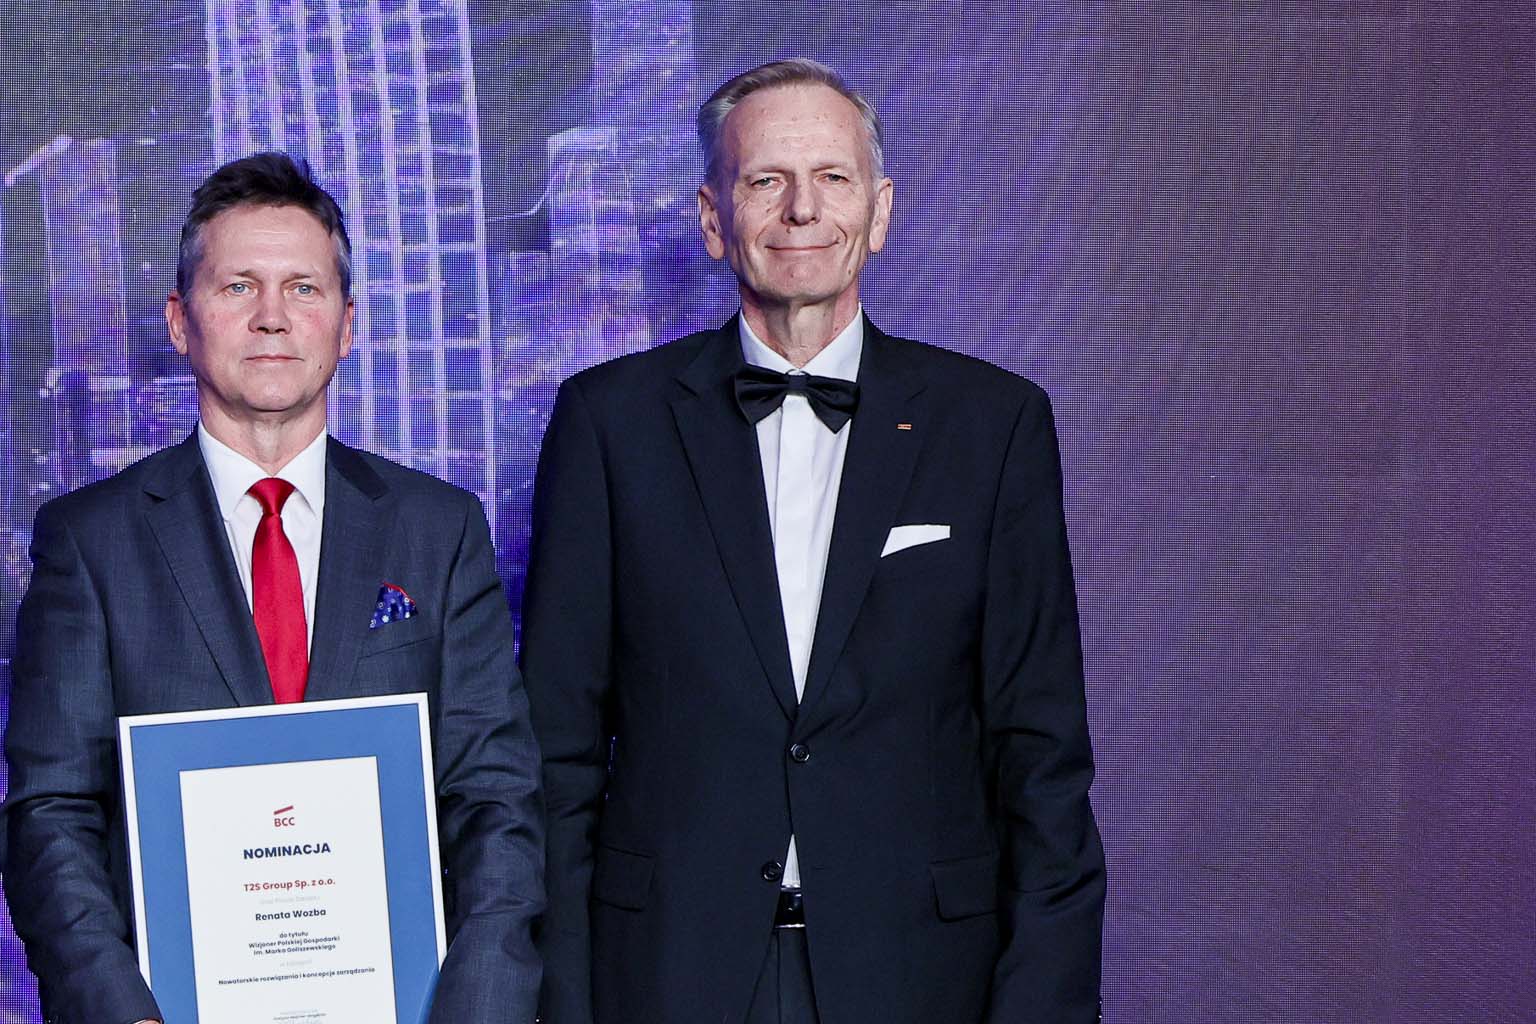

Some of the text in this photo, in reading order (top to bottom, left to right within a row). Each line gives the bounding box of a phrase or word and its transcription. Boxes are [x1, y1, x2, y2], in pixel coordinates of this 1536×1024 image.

[274, 817, 295, 828] BCC
[243, 842, 331, 860] NOMINACJA
[244, 883, 261, 892] T2S
[262, 881, 293, 891] Group
[295, 879, 310, 889] Sp.
[318, 878, 336, 886] o.o.
[255, 908, 327, 921] Renata Wozba
[277, 938, 302, 947] Polskiej
[303, 935, 340, 944] Gospodarki
[265, 947, 286, 955] Marka
